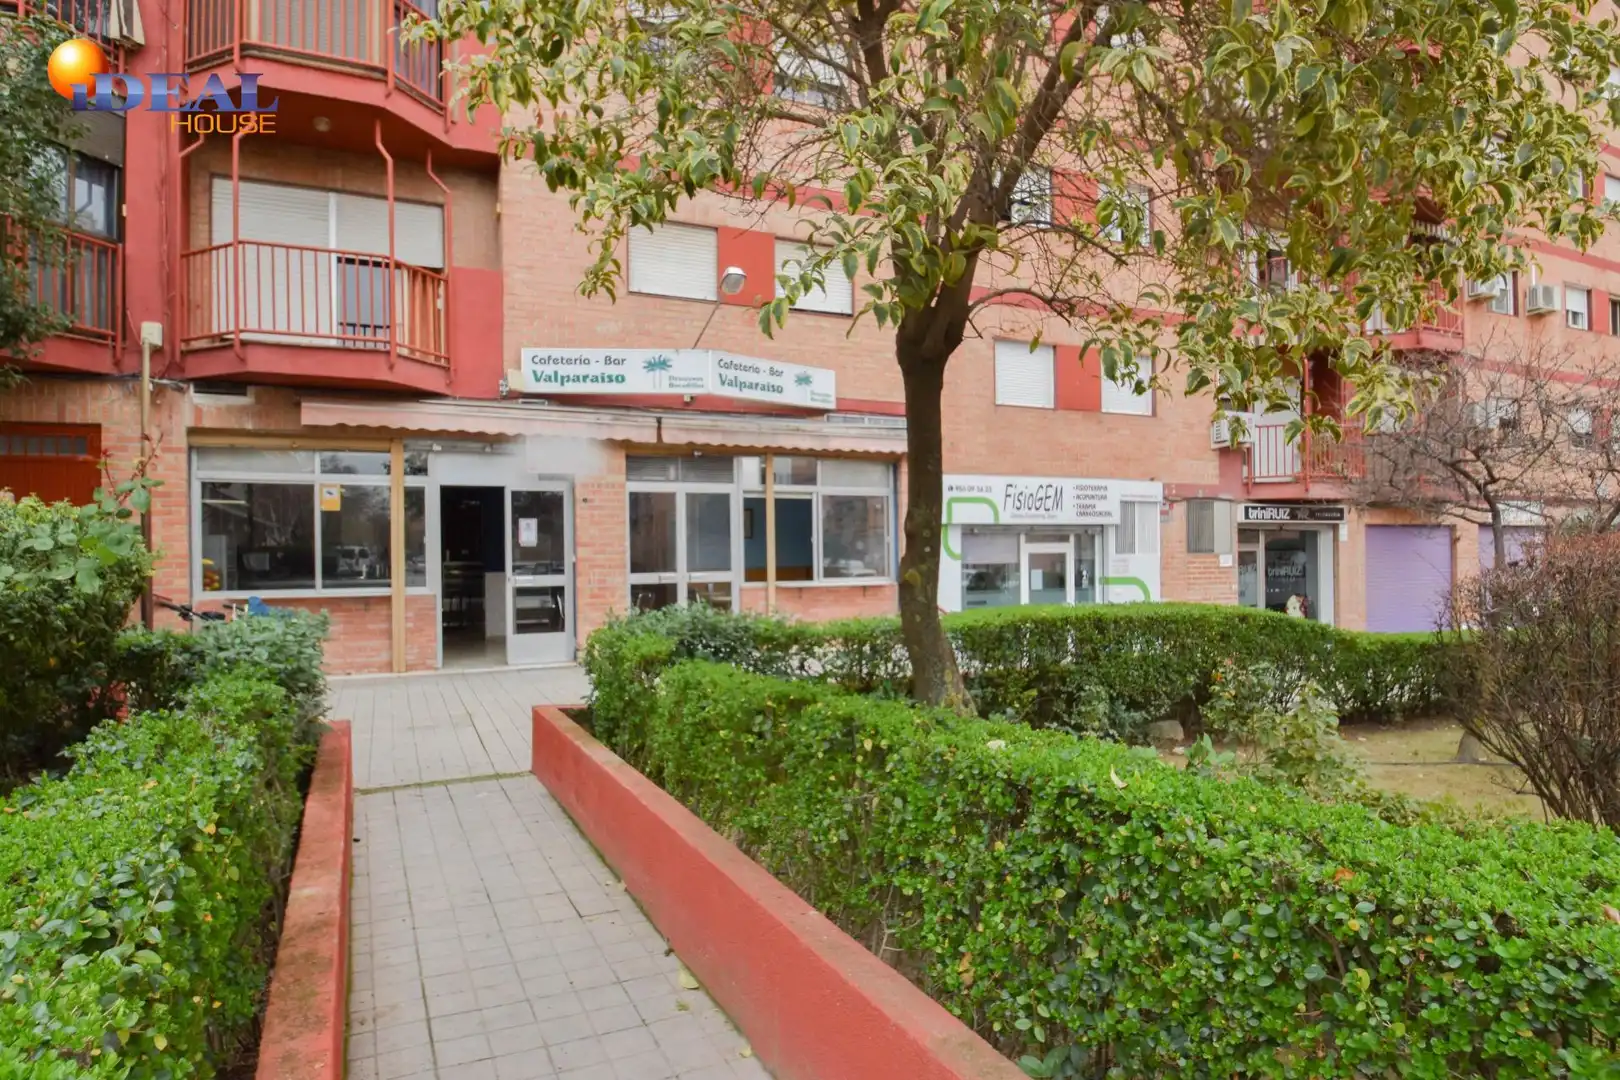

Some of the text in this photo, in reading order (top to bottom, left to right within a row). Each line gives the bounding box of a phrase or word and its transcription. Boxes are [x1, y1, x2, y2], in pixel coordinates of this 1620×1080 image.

[604, 355, 627, 366] Bar
[532, 369, 627, 387] Valparaiso
[769, 366, 784, 377] Bar
[718, 372, 784, 394] Valparaiso
[1003, 484, 1063, 512] FisioGEM
[1248, 507, 1290, 520] triniRUIZ
